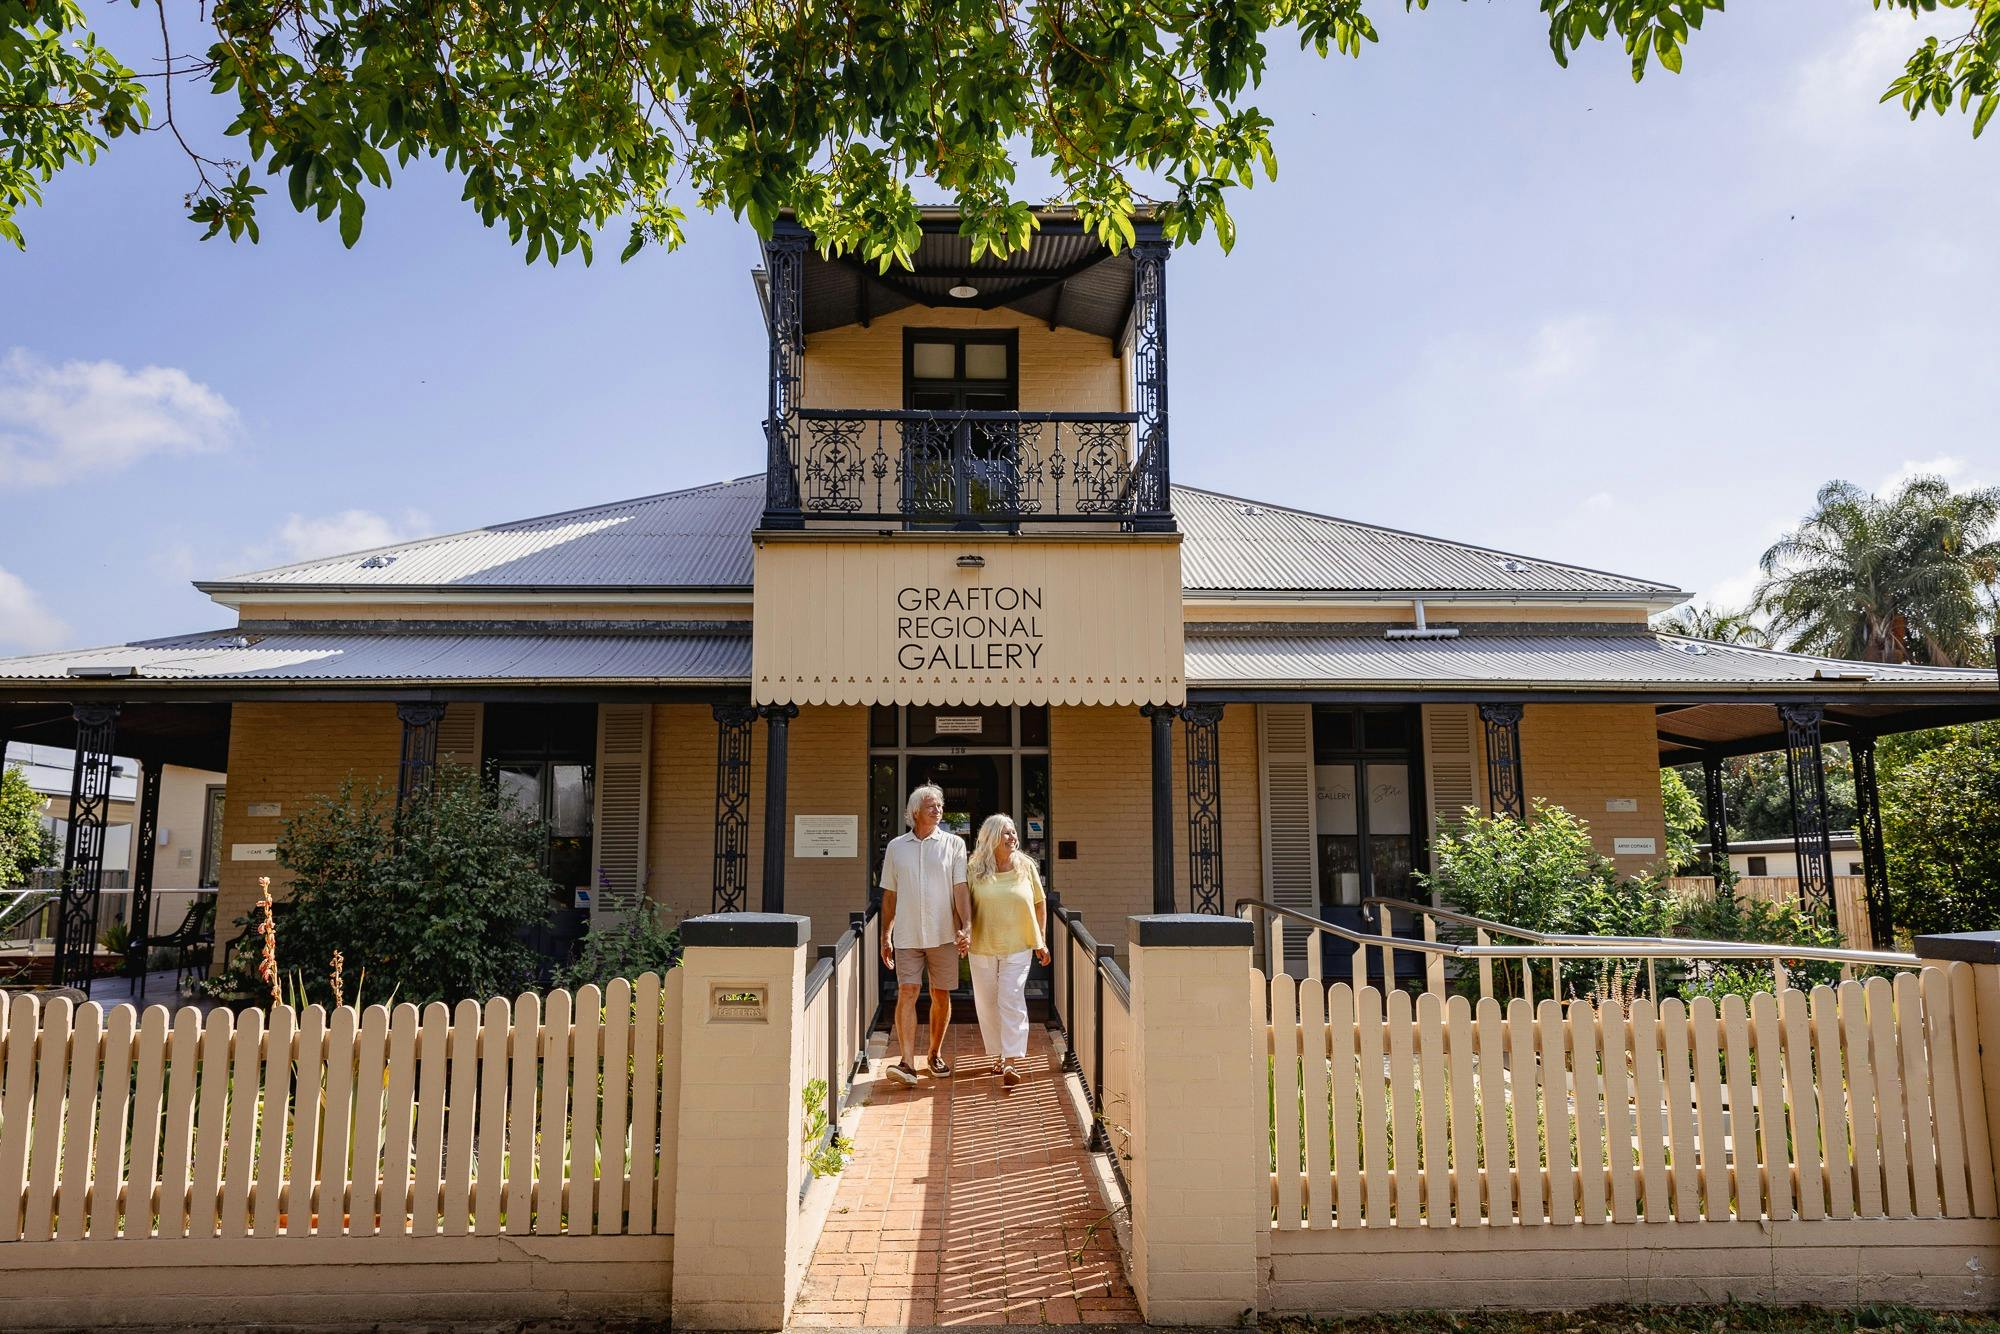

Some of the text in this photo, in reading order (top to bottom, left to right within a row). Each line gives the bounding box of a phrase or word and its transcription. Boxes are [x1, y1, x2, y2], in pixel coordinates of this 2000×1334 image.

[897, 587, 1042, 611] GRAFTON
[898, 616, 1044, 639] REGIONAL
[897, 643, 1044, 671] GALLERY
[1317, 792, 1352, 800] GALLERY
[718, 1007, 761, 1017] LETTERS
